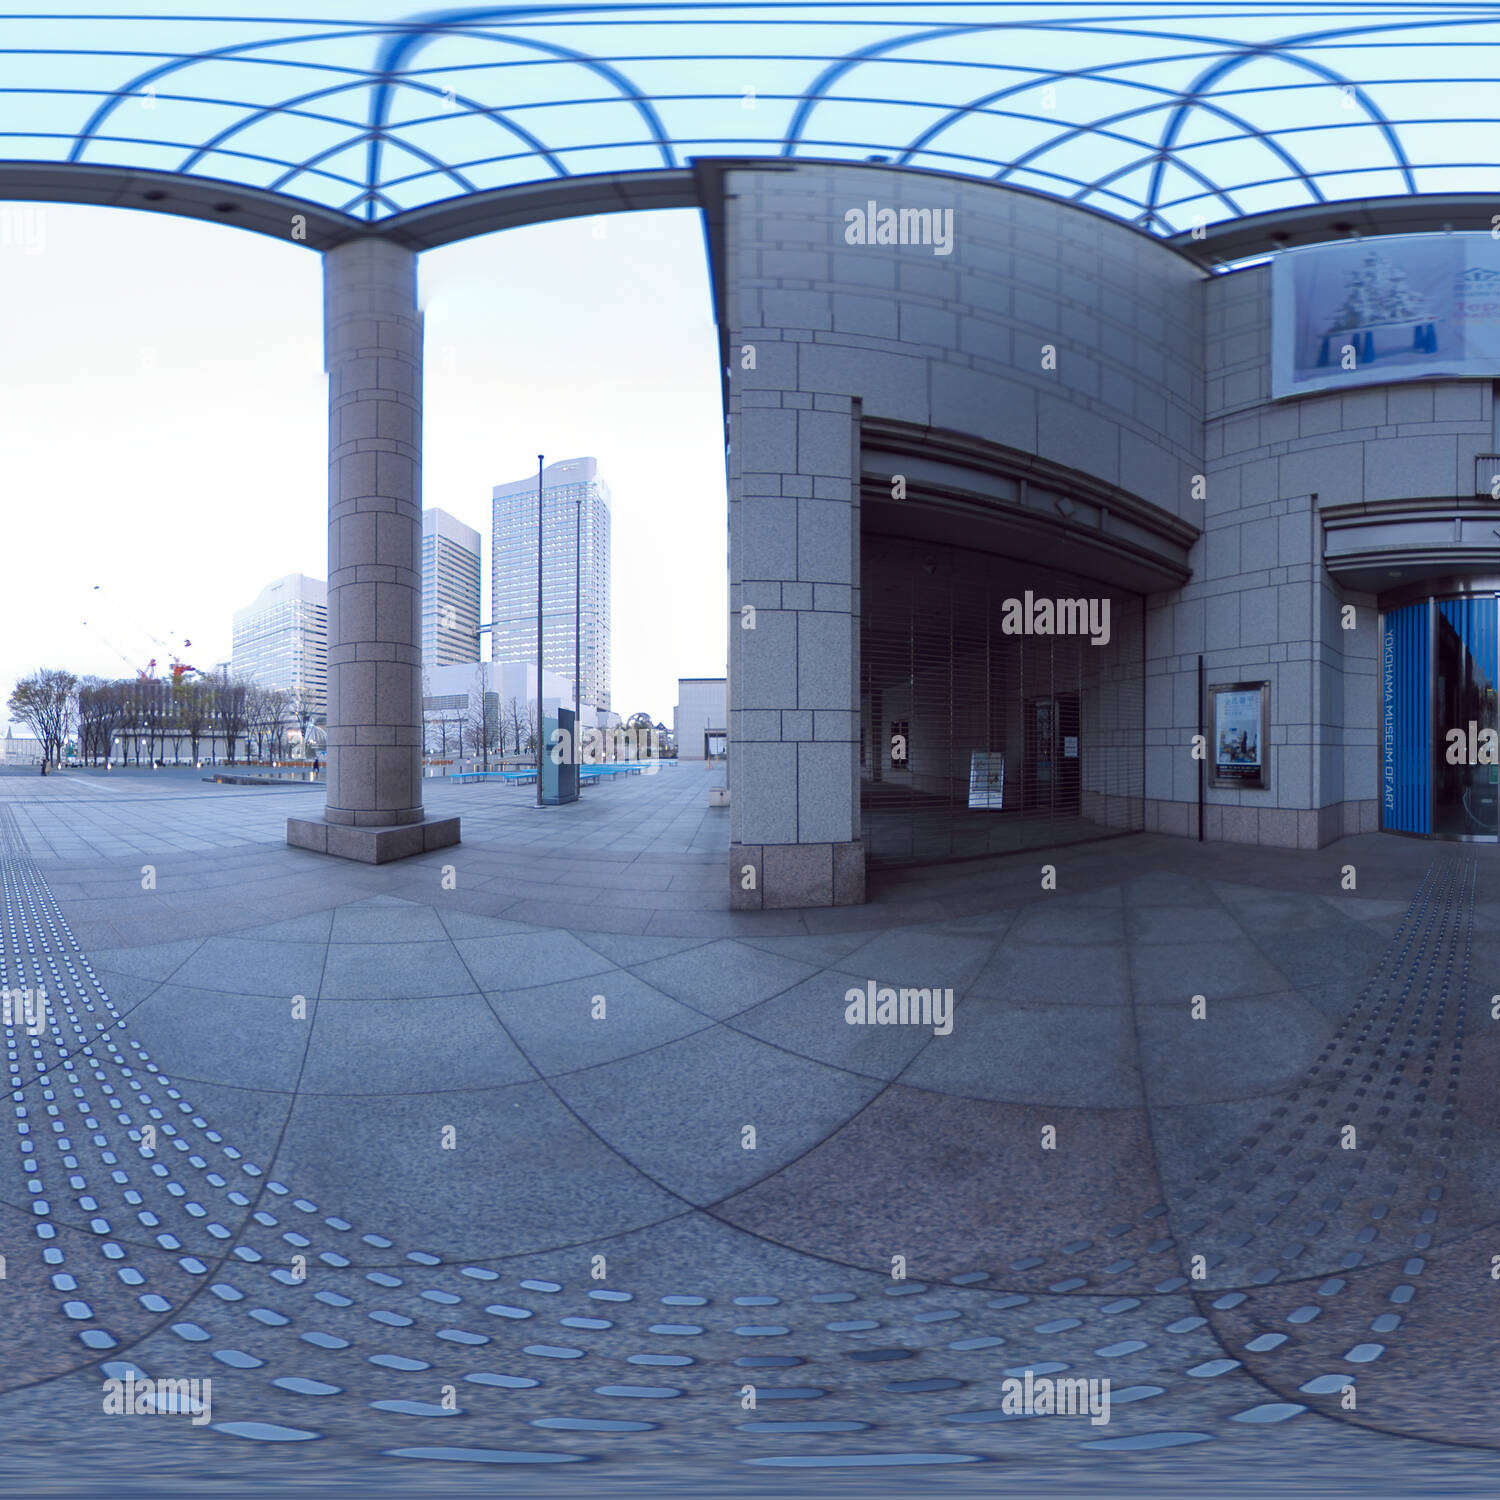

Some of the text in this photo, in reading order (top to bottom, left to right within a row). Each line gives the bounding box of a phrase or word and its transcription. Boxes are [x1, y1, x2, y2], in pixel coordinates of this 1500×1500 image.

[1385, 628, 1394, 810] YOKOHAMA MUSEUM OF ART
